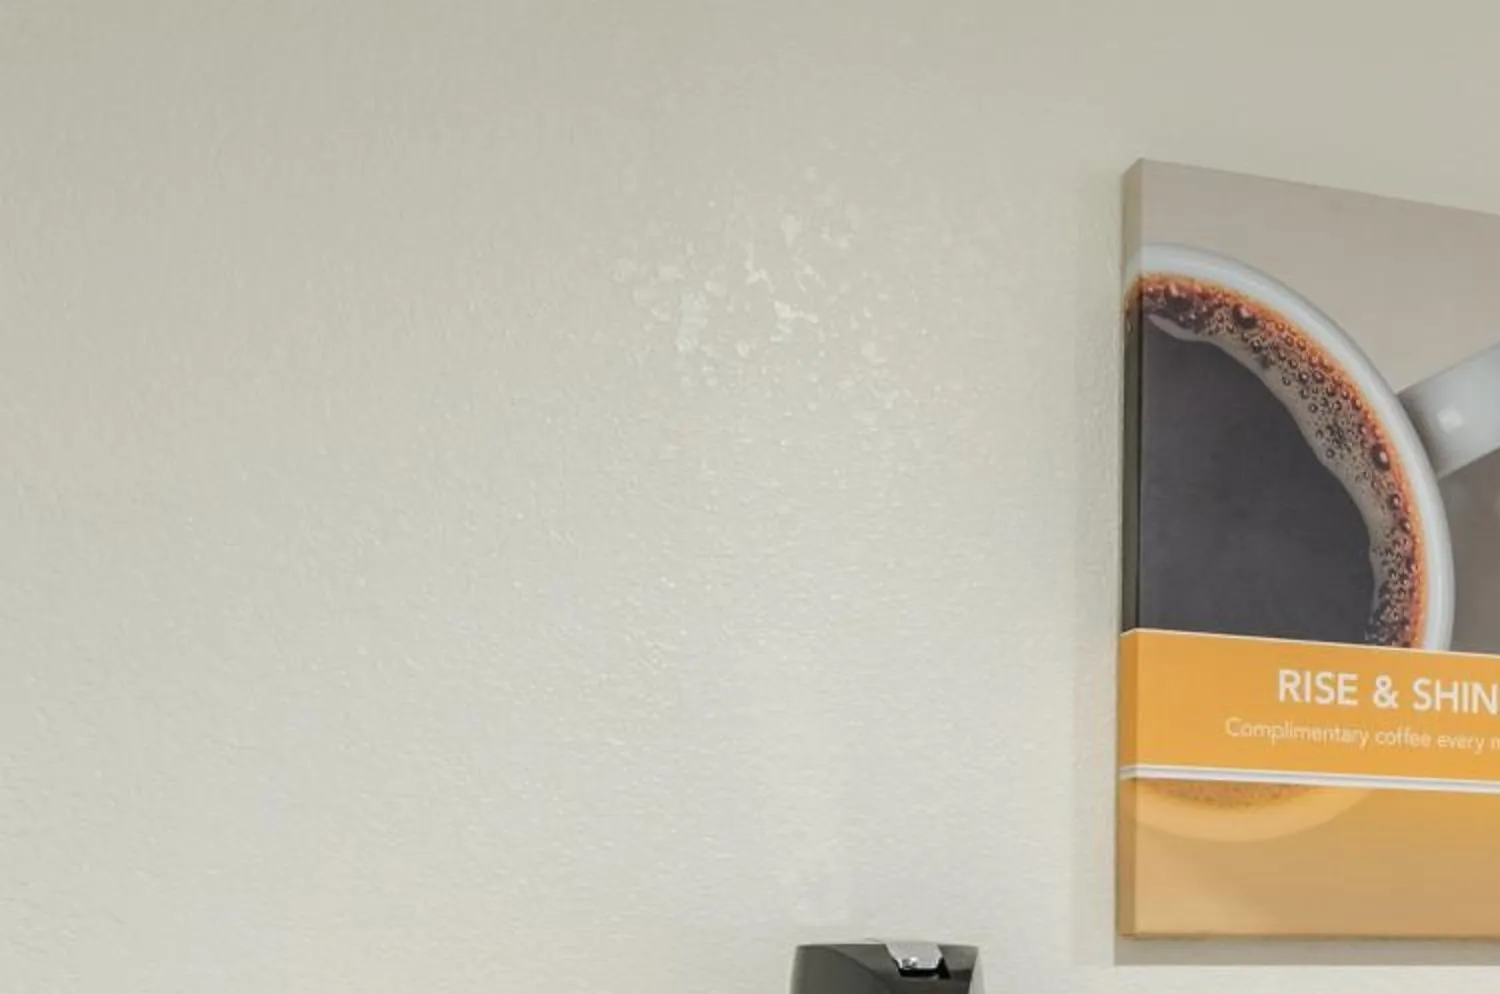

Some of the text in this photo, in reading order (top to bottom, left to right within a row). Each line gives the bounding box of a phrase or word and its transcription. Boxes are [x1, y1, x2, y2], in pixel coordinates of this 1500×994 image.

[1277, 669, 1359, 706] RISE
[1373, 676, 1399, 708] &
[1224, 717, 1369, 749] Complimentary
[1374, 727, 1432, 750] coffee
[1437, 735, 1485, 753] every
